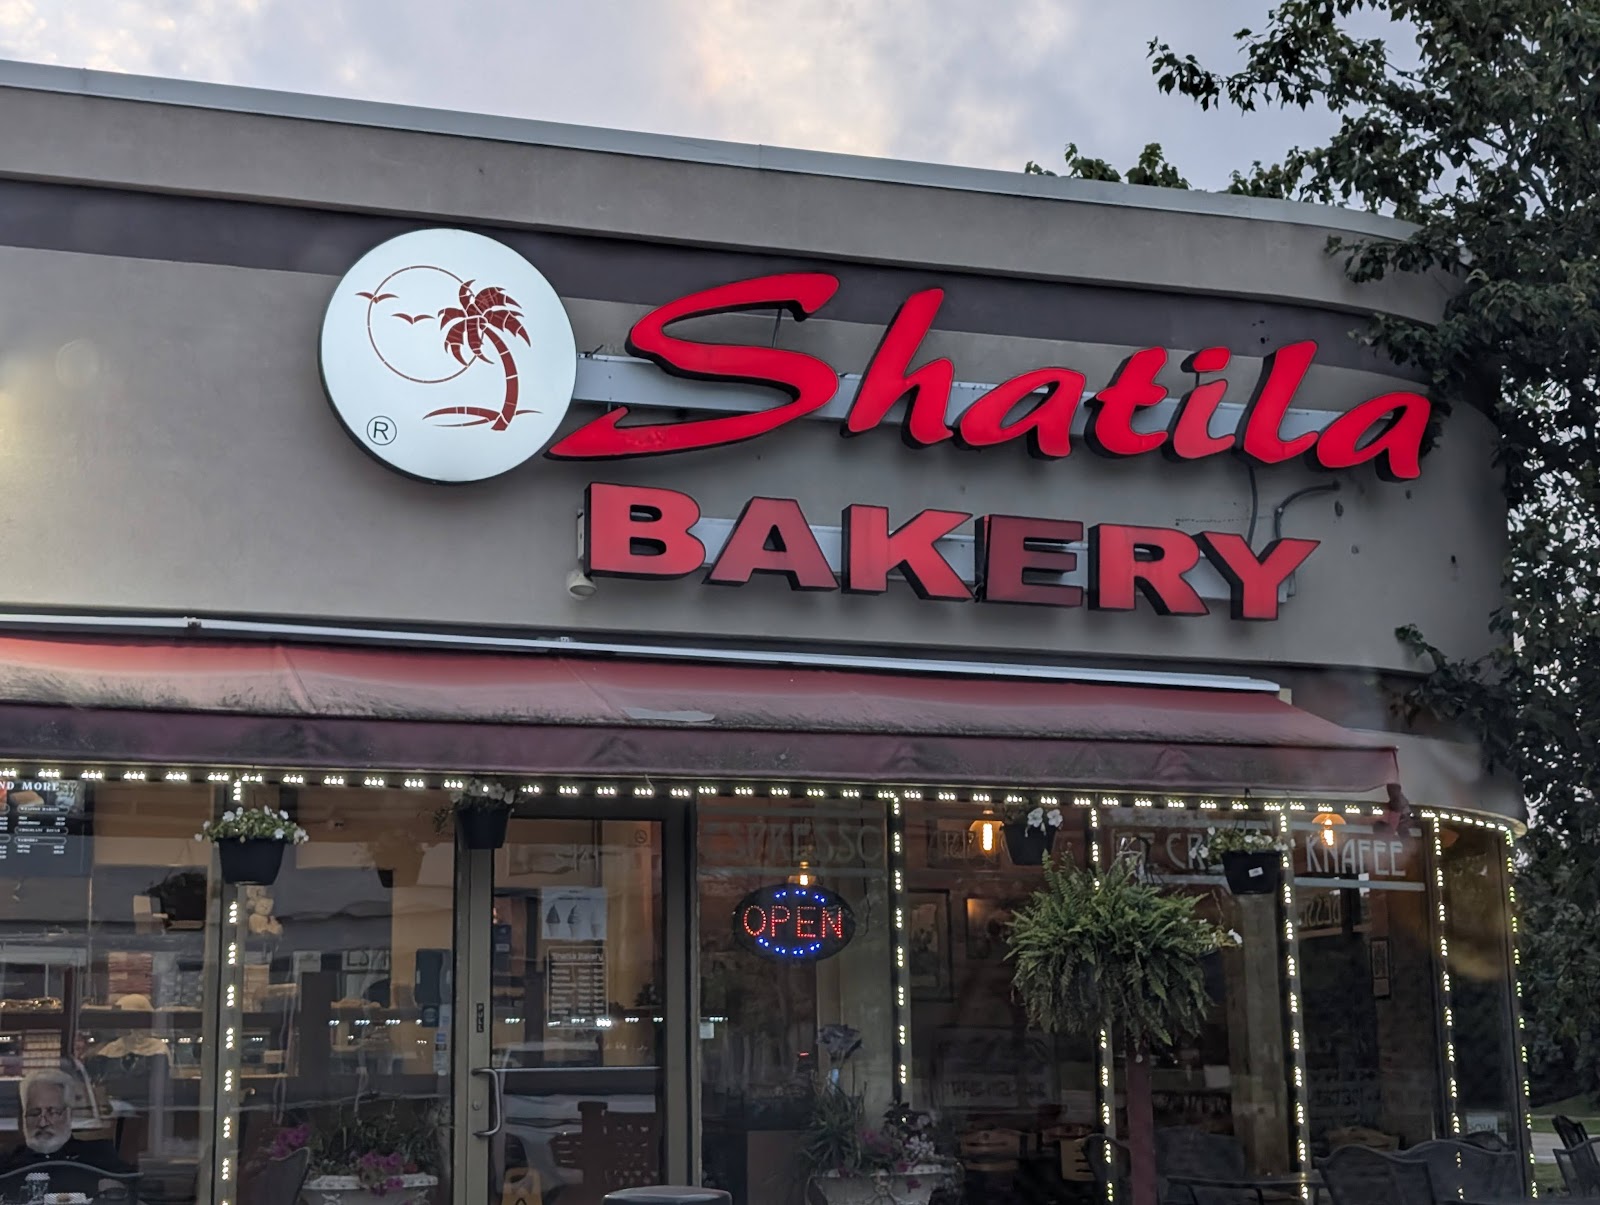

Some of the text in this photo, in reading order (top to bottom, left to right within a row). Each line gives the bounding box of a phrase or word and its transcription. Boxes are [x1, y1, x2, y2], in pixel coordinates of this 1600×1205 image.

[544, 272, 1432, 480] Shatila
[584, 482, 1321, 621] BAKERY
[22, 781, 60, 791] MORE
[1306, 835, 1407, 877] KNAFEE
[743, 904, 843, 938] OPEN
